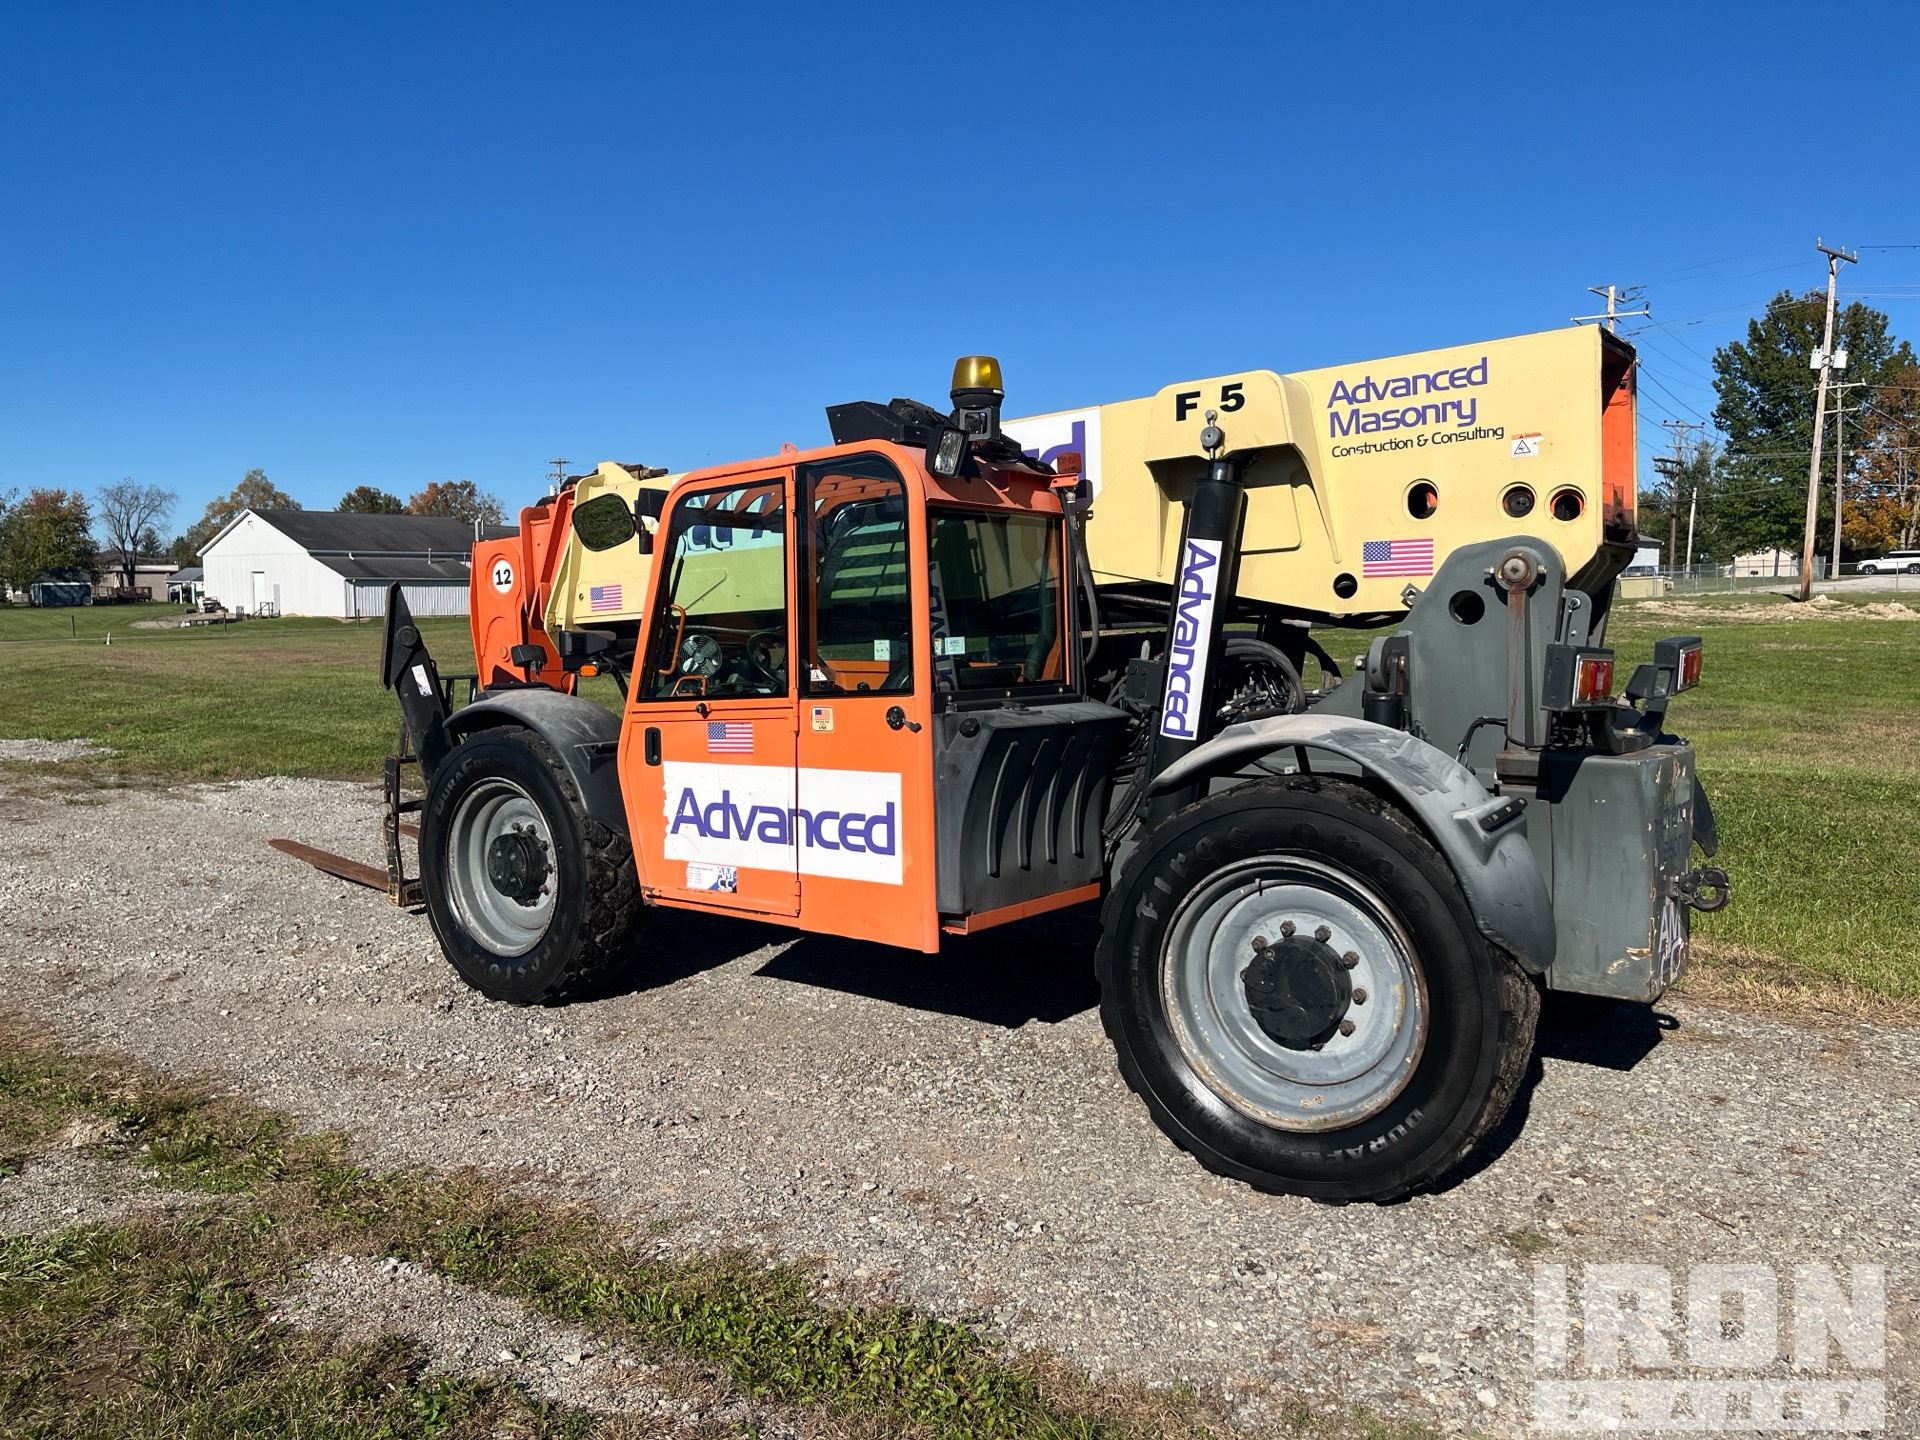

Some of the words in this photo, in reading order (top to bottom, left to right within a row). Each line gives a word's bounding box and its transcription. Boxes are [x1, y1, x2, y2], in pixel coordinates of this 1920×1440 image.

[1176, 391, 1200, 421] F
[1220, 383, 1245, 412] 5
[1327, 357, 1487, 409] Advanced
[1330, 398, 1477, 428] Masonry
[1331, 437, 1414, 458] Construction
[1417, 434, 1429, 447] &
[1431, 426, 1505, 445] Consulting
[495, 569, 512, 586] 12
[1162, 541, 1217, 737] Advanced
[670, 787, 896, 856] Advanced
